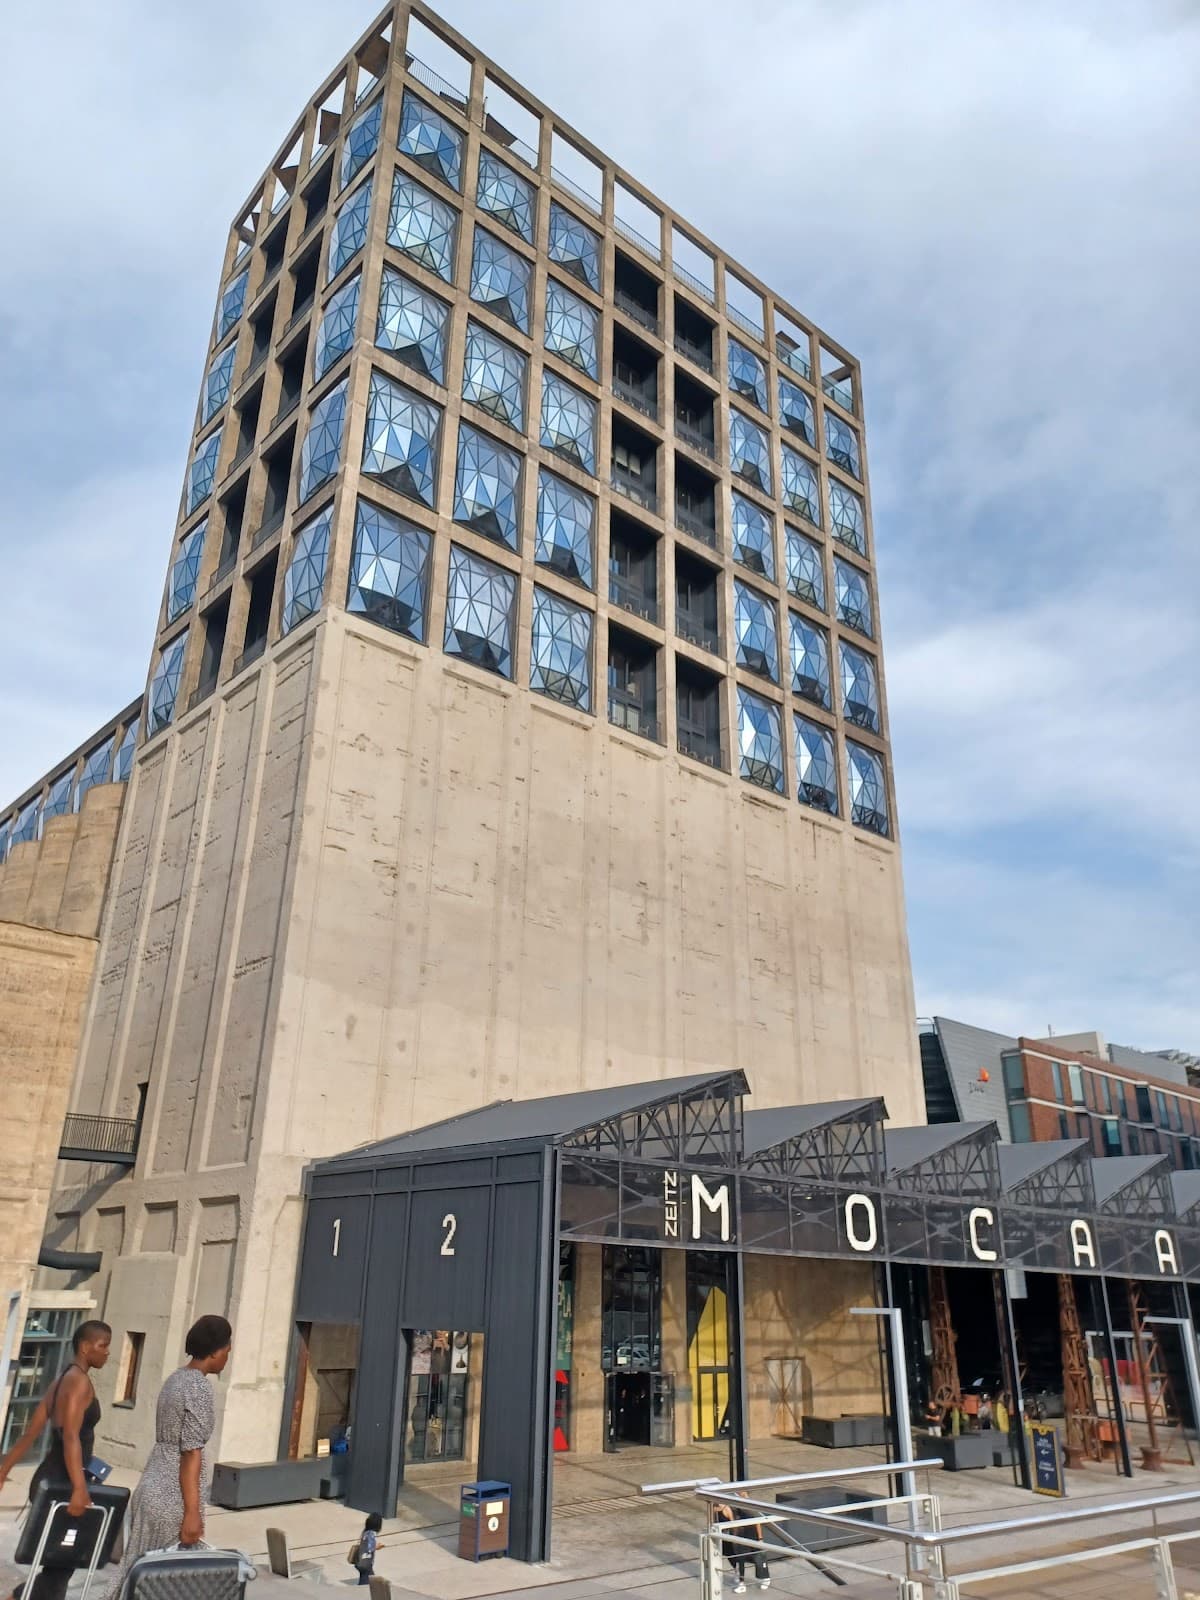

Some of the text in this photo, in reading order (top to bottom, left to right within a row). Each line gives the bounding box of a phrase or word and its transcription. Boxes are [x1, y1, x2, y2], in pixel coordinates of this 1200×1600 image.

[664, 1170, 678, 1237] ZEITZ
[332, 1218, 341, 1257] 1
[440, 1213, 457, 1256] 2
